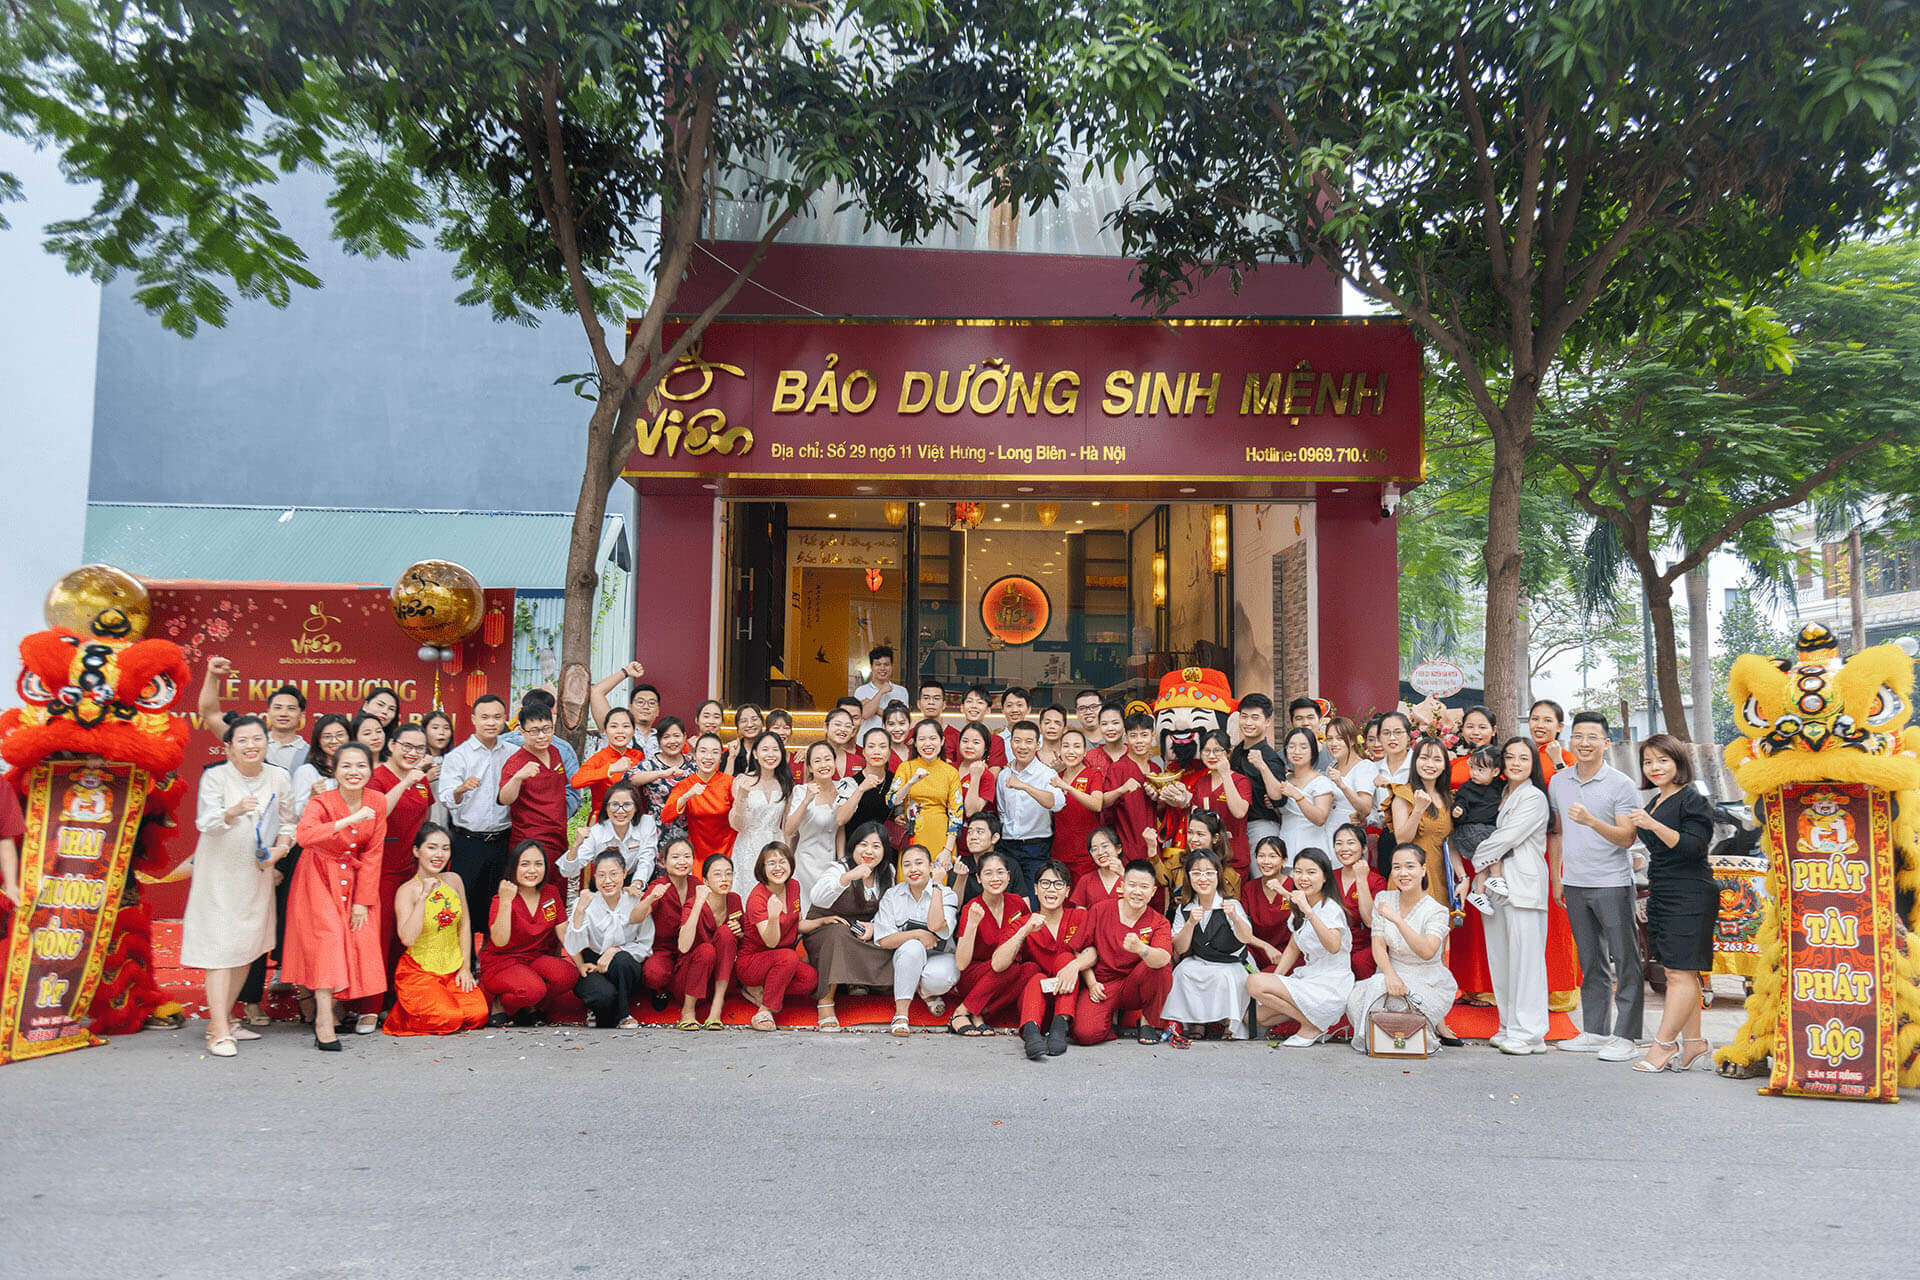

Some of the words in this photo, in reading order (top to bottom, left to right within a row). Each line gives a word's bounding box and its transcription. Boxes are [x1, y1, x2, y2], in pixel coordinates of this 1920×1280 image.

[771, 352, 878, 414] BẢO
[897, 356, 1081, 415] DƯỠNG
[1101, 369, 1222, 415] SINH
[1239, 359, 1389, 426] MỆNH
[771, 443, 794, 462] Địa
[798, 442, 824, 459] chỉ:
[827, 441, 846, 459] Số
[849, 443, 866, 458] 29
[870, 444, 896, 463] ngõ
[899, 445, 912, 459] 11
[918, 444, 945, 463] Việt
[950, 445, 986, 463] Hưng
[998, 445, 1033, 464] Long
[1036, 445, 1067, 460] Biên
[1080, 446, 1099, 461] Hà
[1103, 446, 1126, 464] Nội
[1245, 447, 1297, 463] Hotline:
[1792, 853, 1869, 893] PHÁT
[1802, 907, 1859, 948] TÀI
[1794, 963, 1874, 1005] PHÁT
[1806, 1018, 1864, 1067] LỘC
